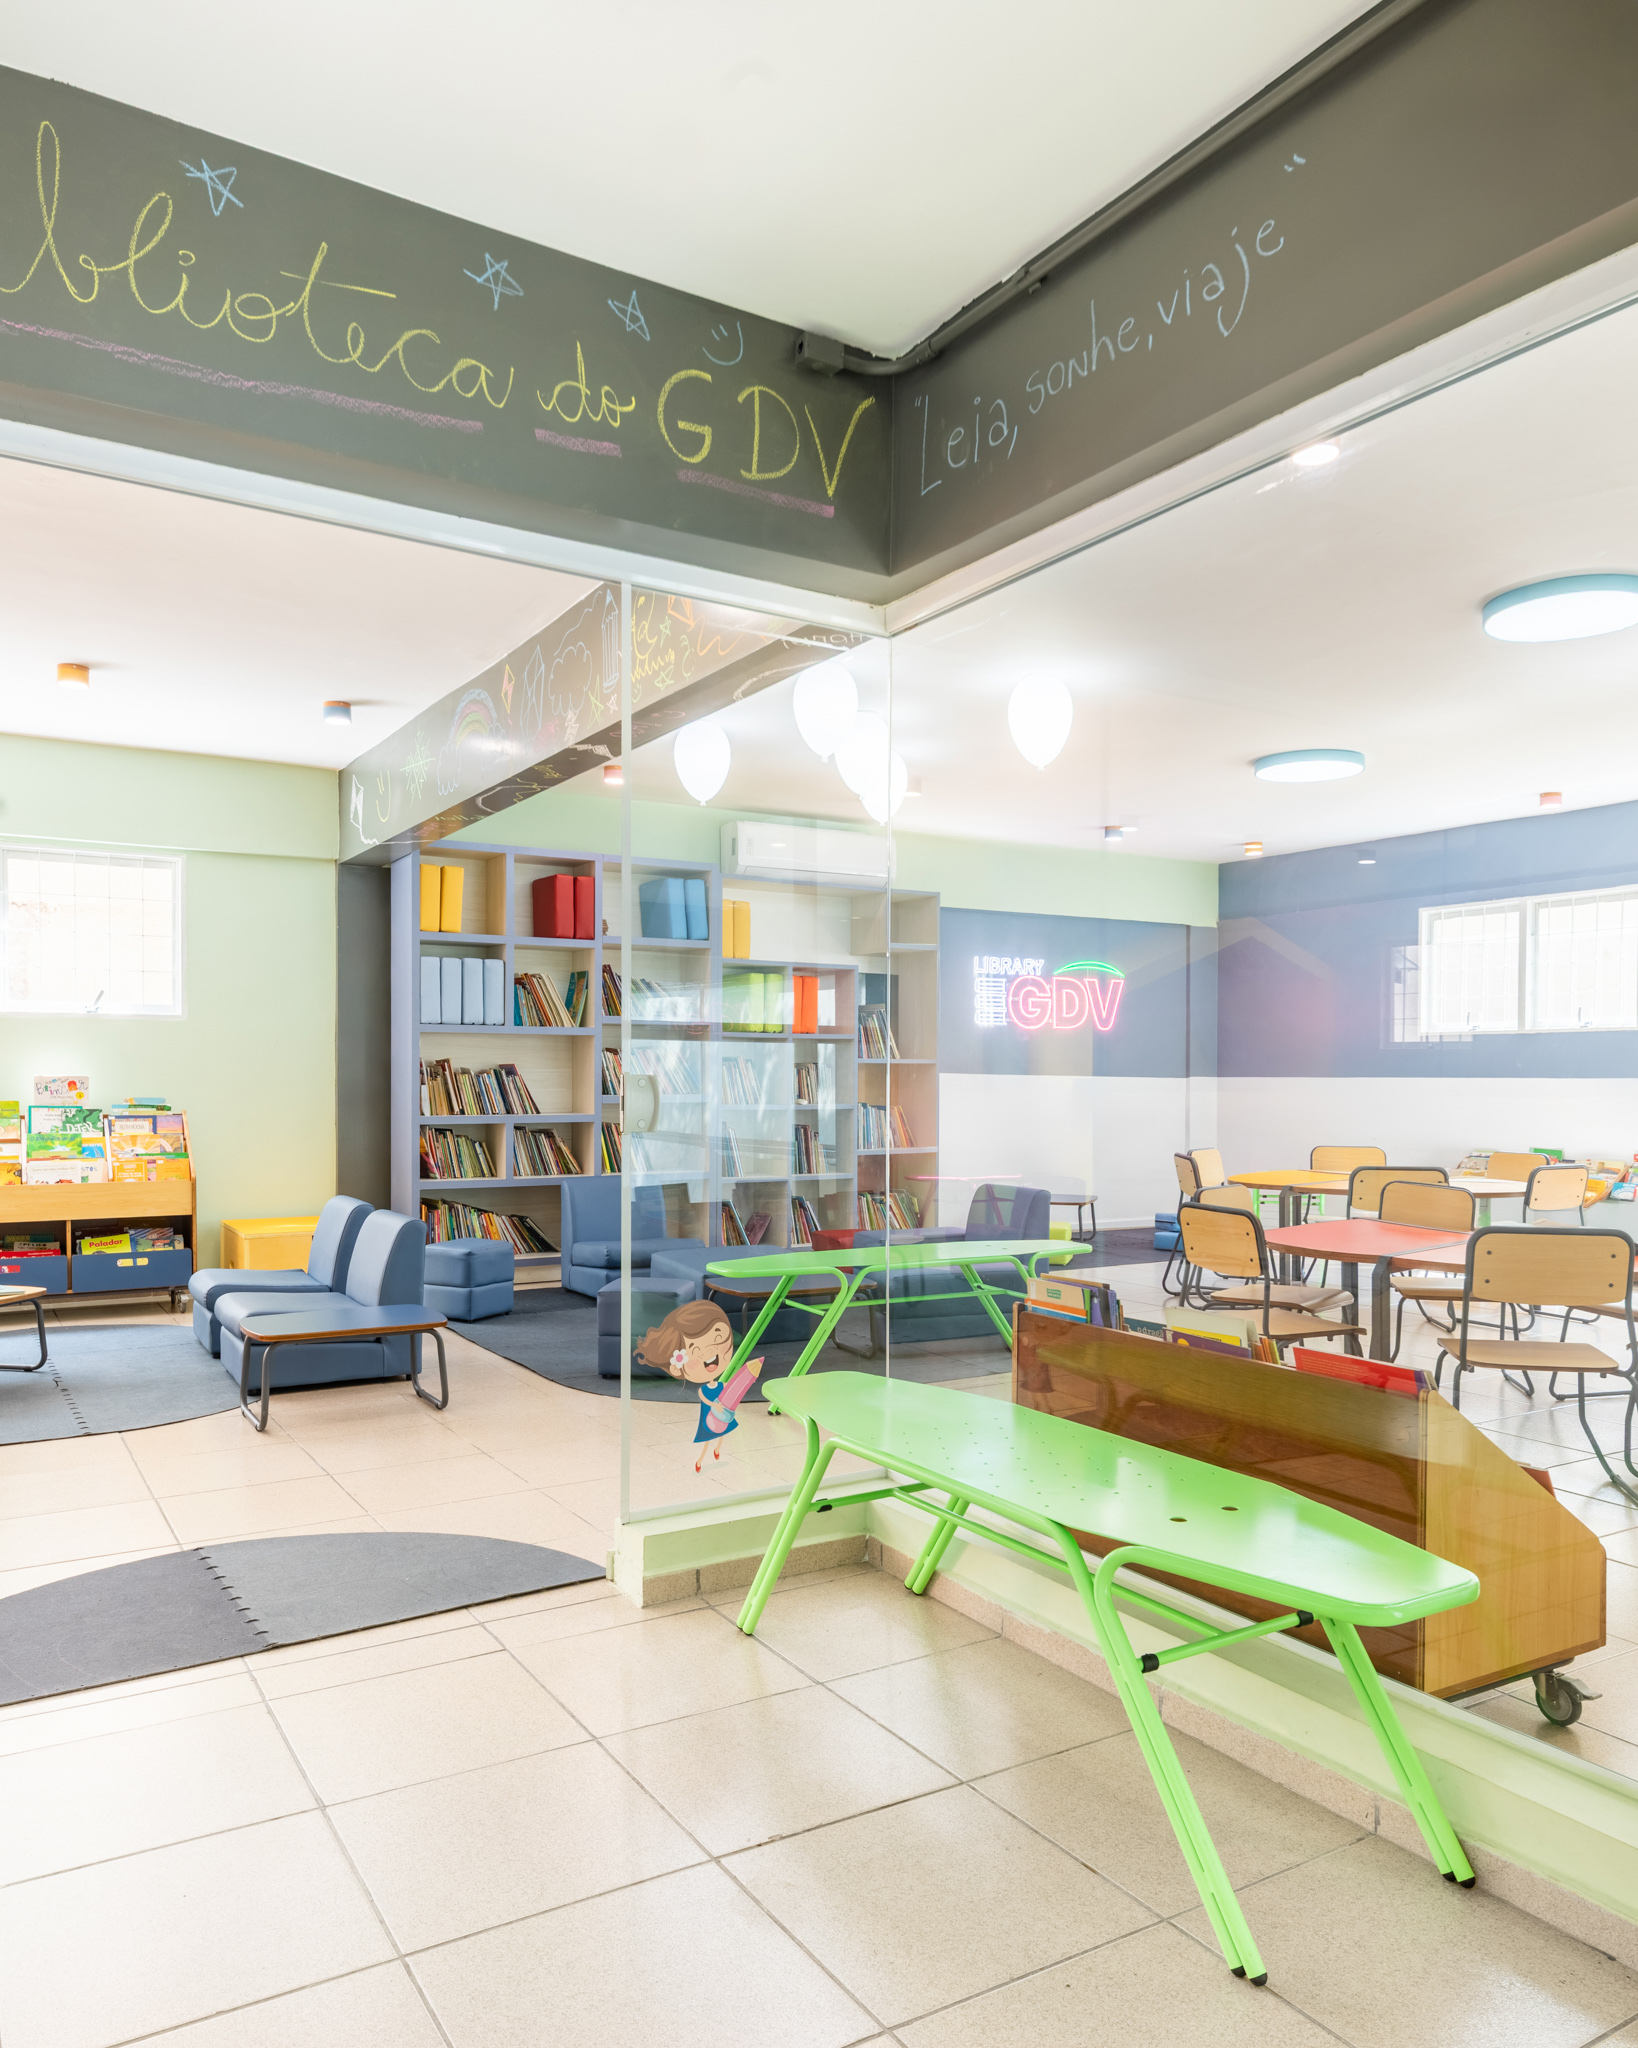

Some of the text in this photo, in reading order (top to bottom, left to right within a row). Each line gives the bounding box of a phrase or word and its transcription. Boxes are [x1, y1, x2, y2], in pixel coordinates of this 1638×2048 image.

[1025, 299, 1153, 414] sonhe,
[537, 340, 636, 428] do
[656, 369, 876, 498] GDV
[973, 956, 1045, 976] LIBRARY
[1009, 975, 1125, 1031] GDV
[88, 1238, 124, 1248] Paladar
